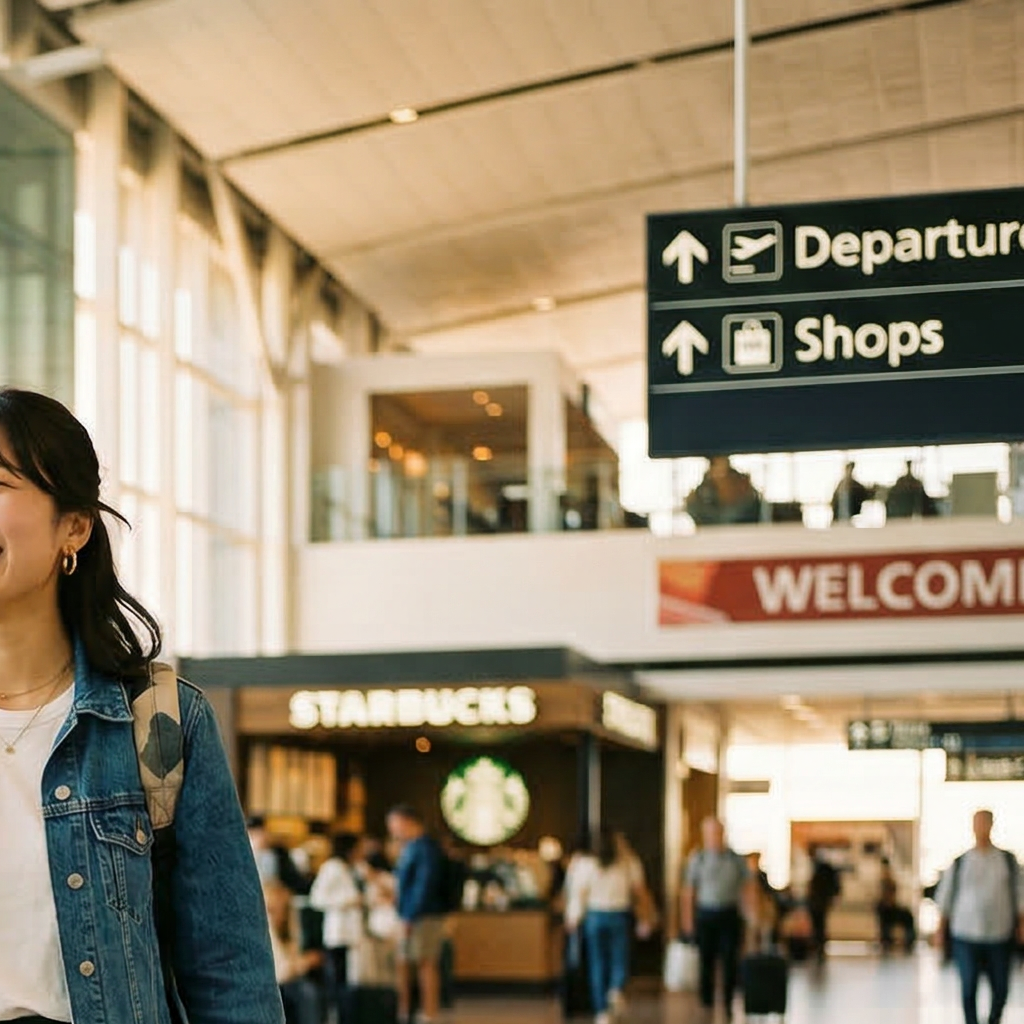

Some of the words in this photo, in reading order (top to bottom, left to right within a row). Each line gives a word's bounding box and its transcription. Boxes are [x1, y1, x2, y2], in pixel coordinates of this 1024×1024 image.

[794, 217, 1024, 276] Departur
[794, 314, 945, 368] Shops
[752, 557, 1024, 615] WELCOM
[289, 685, 537, 730] STARBUCKS
